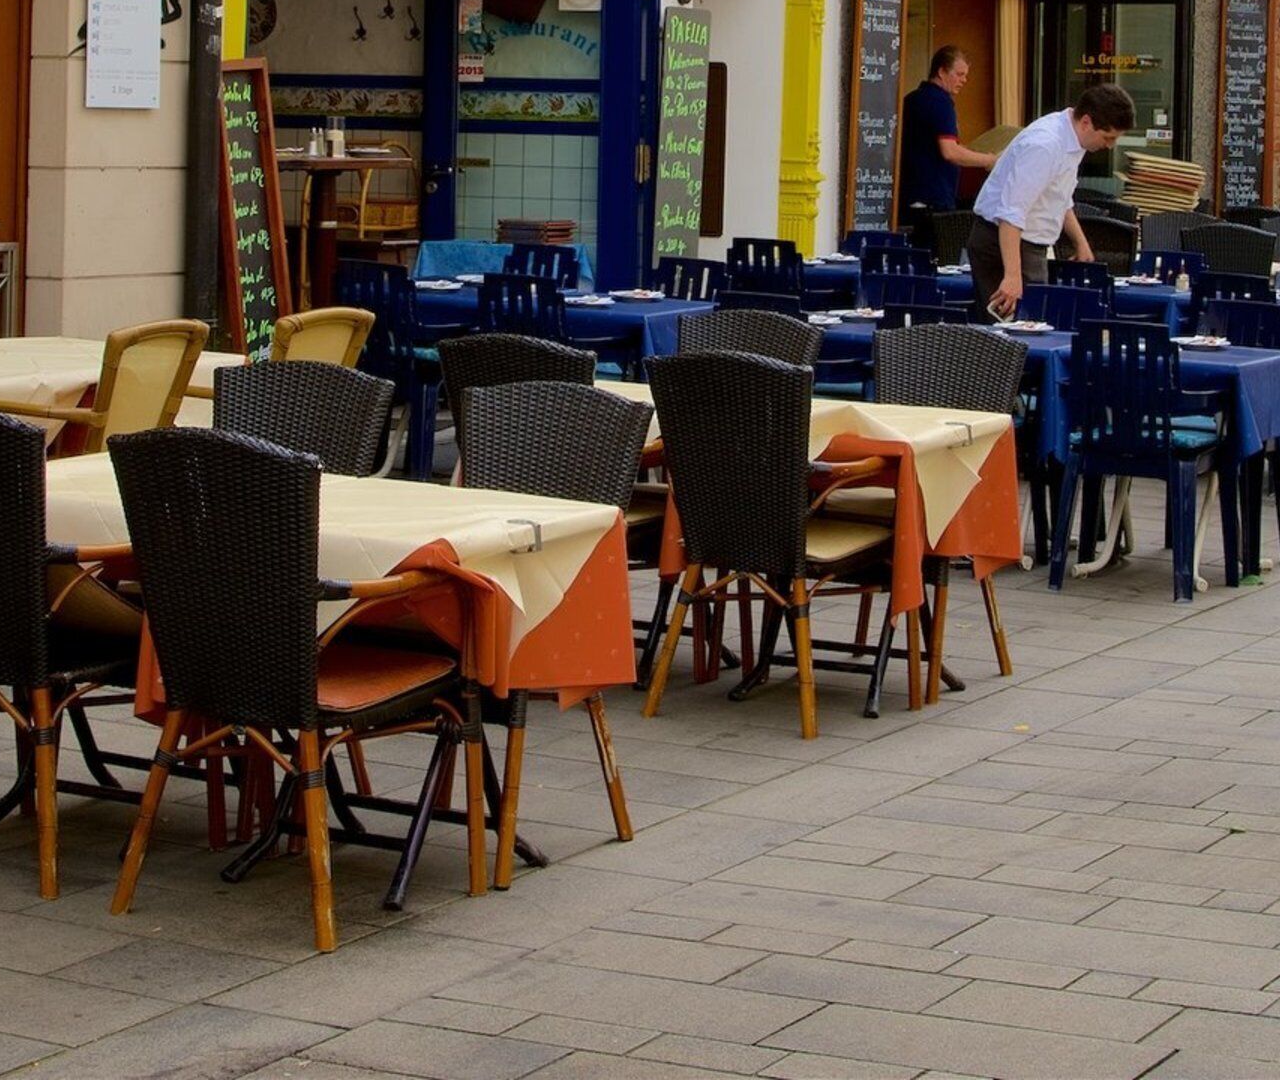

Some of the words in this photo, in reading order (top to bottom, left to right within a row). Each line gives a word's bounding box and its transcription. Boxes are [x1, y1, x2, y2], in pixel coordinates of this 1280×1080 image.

[469, 19, 598, 56] Restaurant
[671, 16, 708, 46] PAELLA
[460, 66, 483, 76] 2013
[1082, 54, 1095, 65] La
[1098, 53, 1138, 67] Grappa
